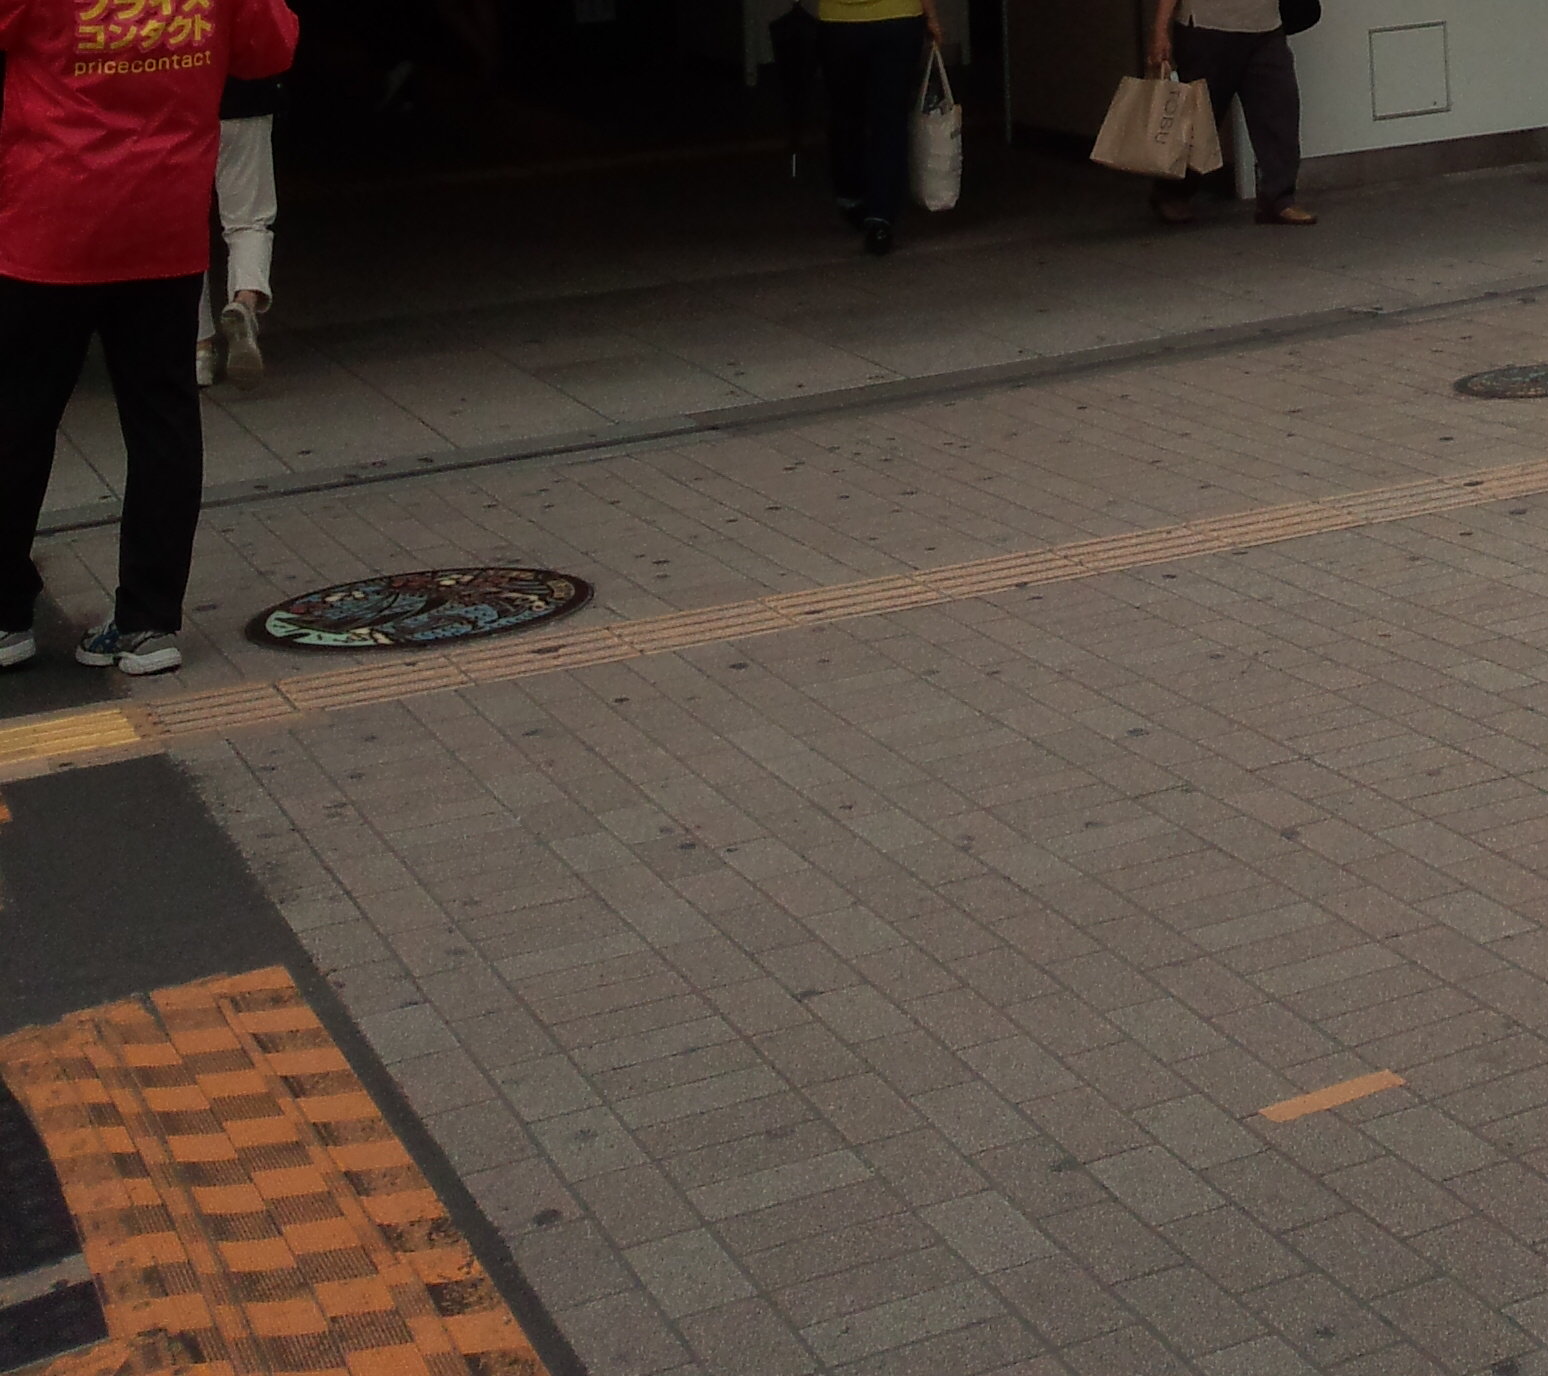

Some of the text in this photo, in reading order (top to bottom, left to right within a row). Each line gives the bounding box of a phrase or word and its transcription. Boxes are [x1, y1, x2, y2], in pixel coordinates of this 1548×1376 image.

[76, 13, 212, 49] コンタクト
[74, 50, 212, 77] pricecontact
[1154, 89, 1181, 145] TOBU
